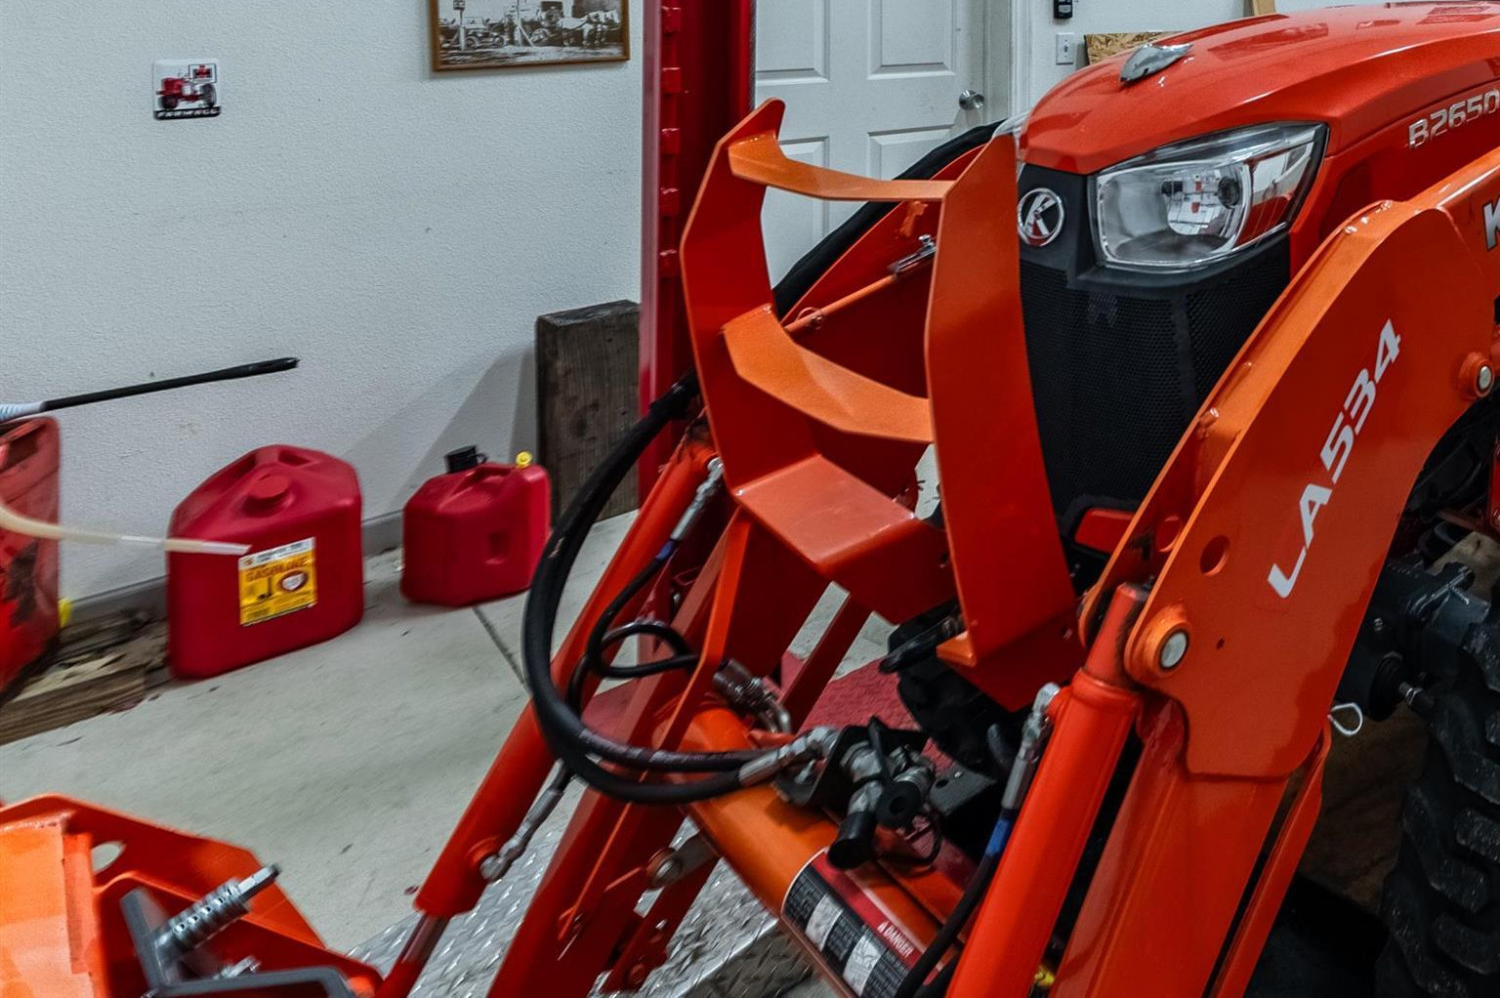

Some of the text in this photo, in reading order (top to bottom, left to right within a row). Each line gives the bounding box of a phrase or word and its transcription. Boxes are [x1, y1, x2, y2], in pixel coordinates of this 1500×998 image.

[1408, 88, 1500, 150] B2650
[1267, 318, 1401, 599] LA534
[246, 554, 309, 582] GASOLINE
[886, 924, 915, 958] DANGER
